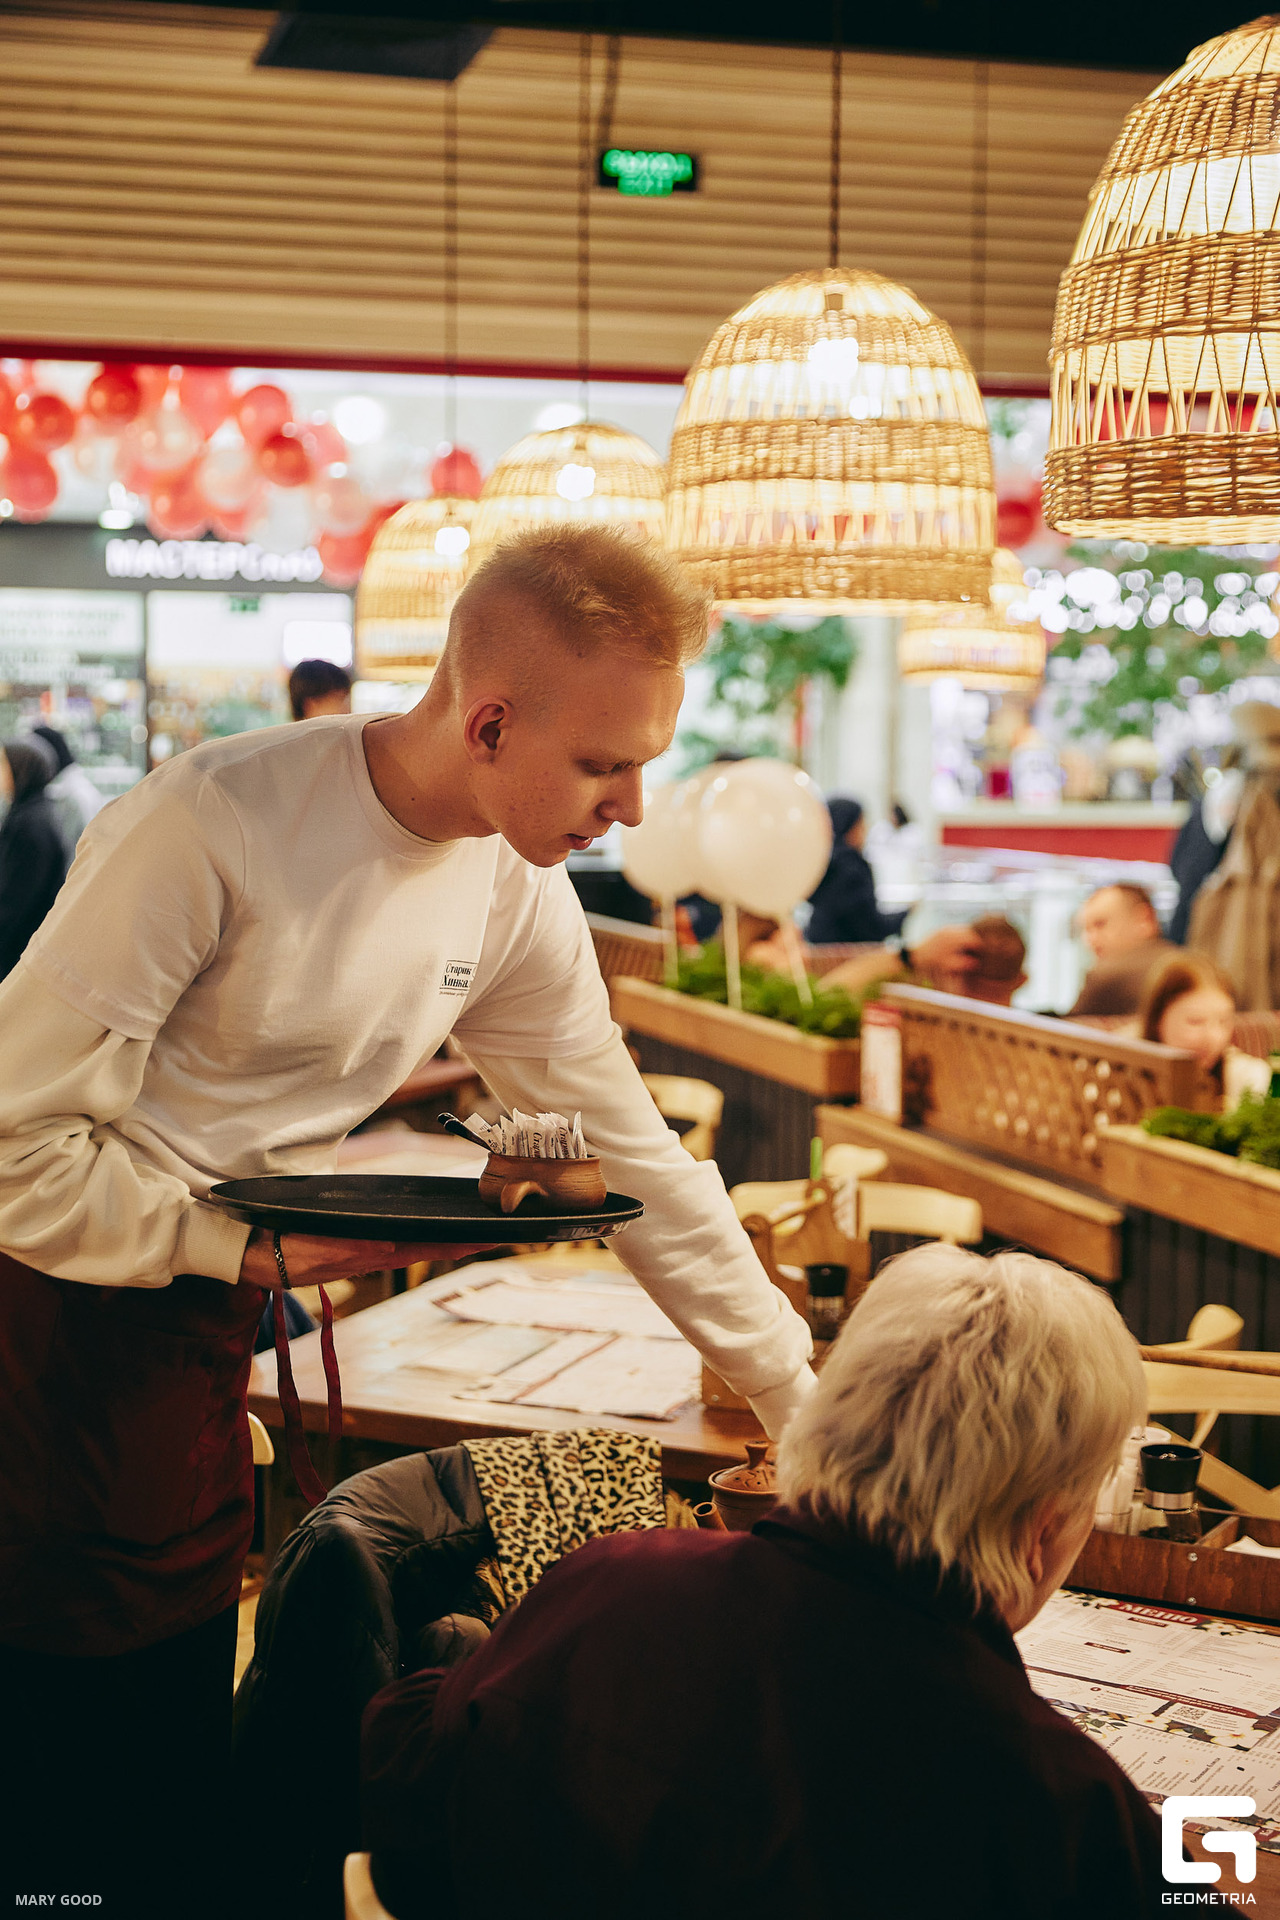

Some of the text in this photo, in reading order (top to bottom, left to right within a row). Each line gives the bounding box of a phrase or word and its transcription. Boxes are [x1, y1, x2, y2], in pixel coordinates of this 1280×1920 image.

[446, 963, 472, 976] Старик
[441, 974, 471, 988] Хинка
[1119, 1603, 1198, 1624] МЕНЮ
